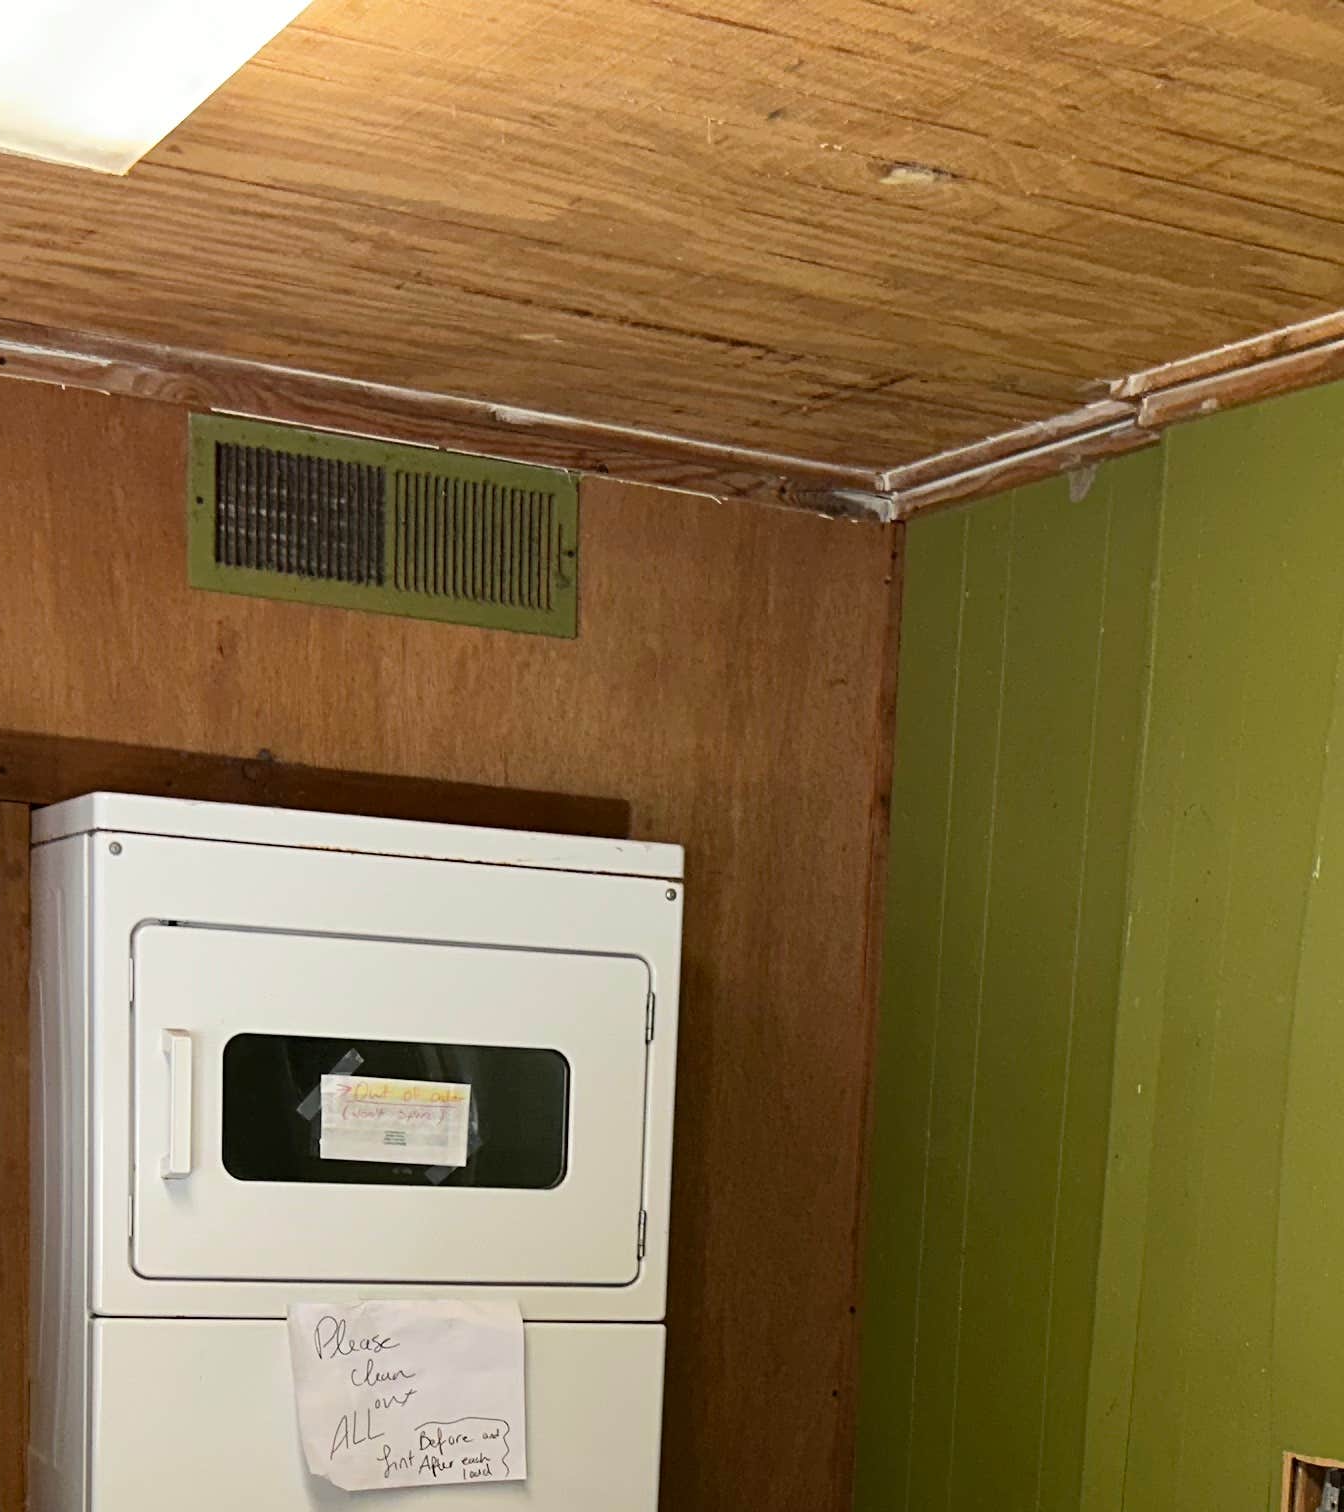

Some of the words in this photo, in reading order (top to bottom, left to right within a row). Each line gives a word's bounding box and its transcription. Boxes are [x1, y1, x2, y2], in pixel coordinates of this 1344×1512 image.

[314, 1315, 400, 1360] Please
[330, 1408, 385, 1460] ALL
[419, 1427, 472, 1454] Before
